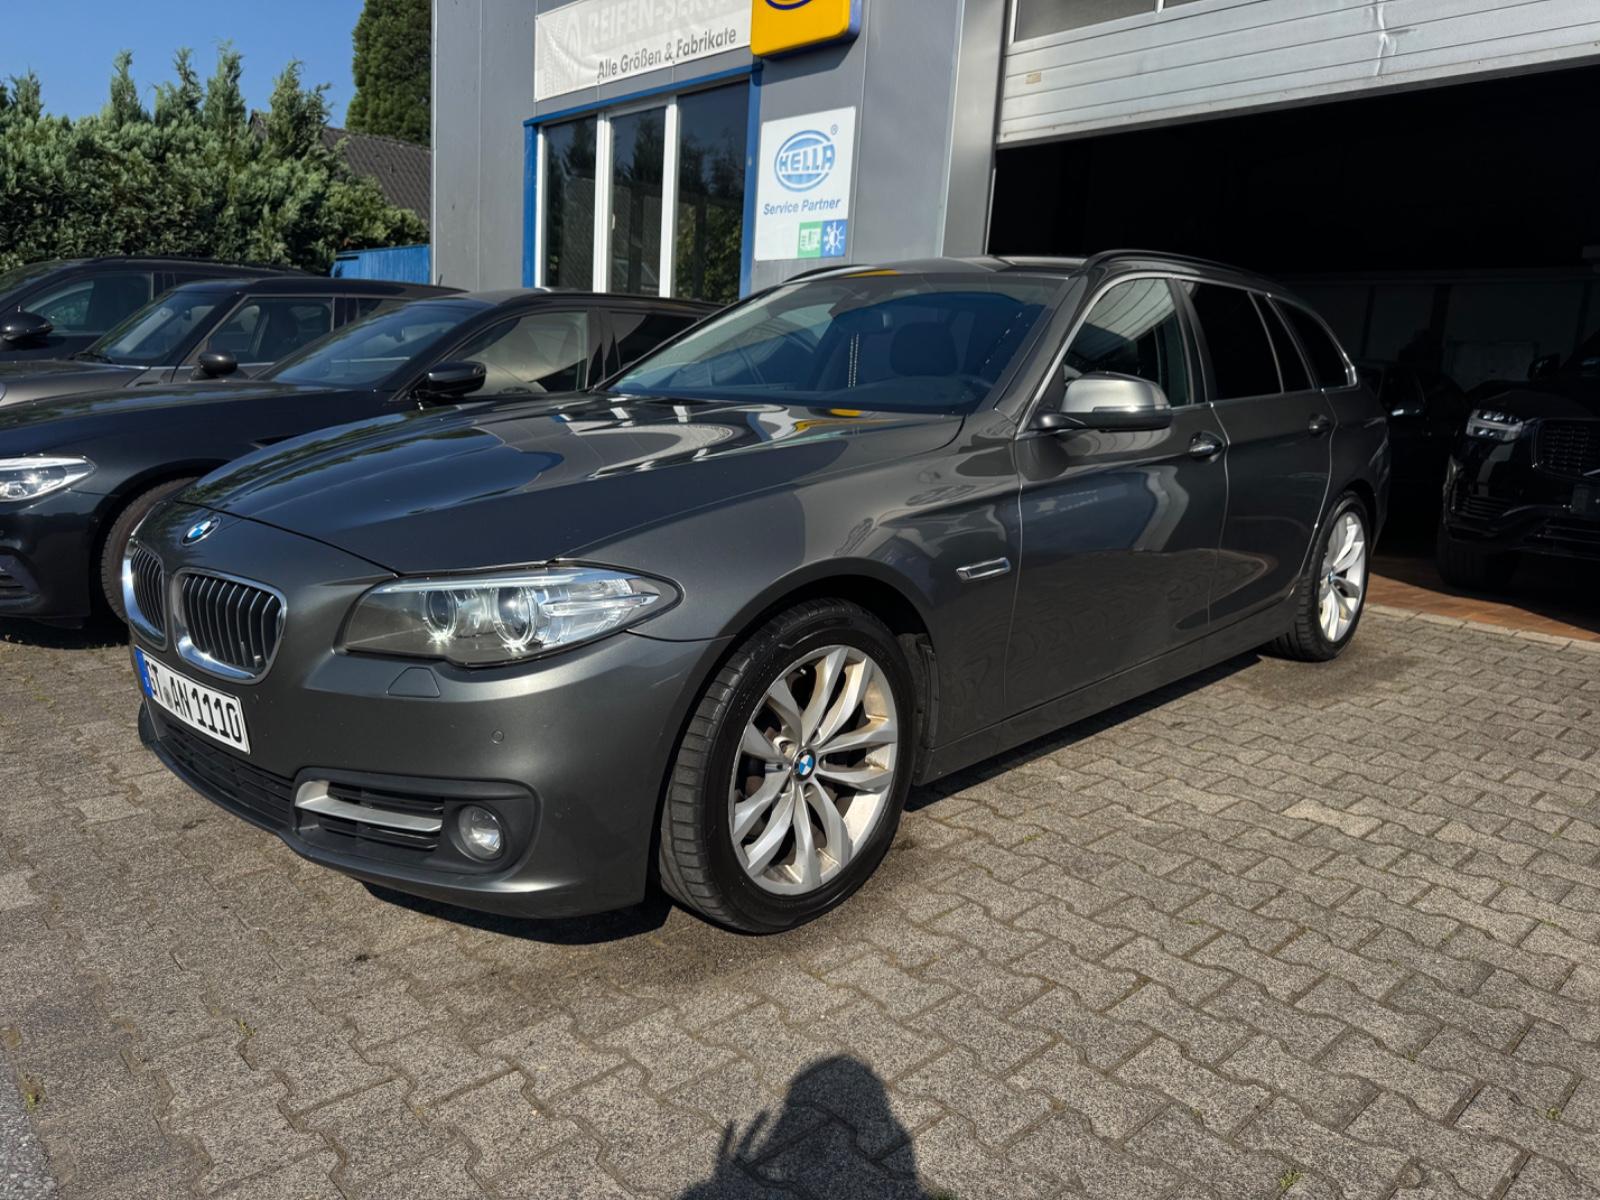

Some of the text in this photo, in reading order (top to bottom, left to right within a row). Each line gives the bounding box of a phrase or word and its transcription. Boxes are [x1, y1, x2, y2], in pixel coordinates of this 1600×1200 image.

[597, 27, 737, 79] Alle Größen & Fabrikate
[779, 144, 836, 173] HELLA
[763, 198, 841, 216] Service Partner
[169, 675, 195, 723] AN
[191, 687, 243, 744] 1110
